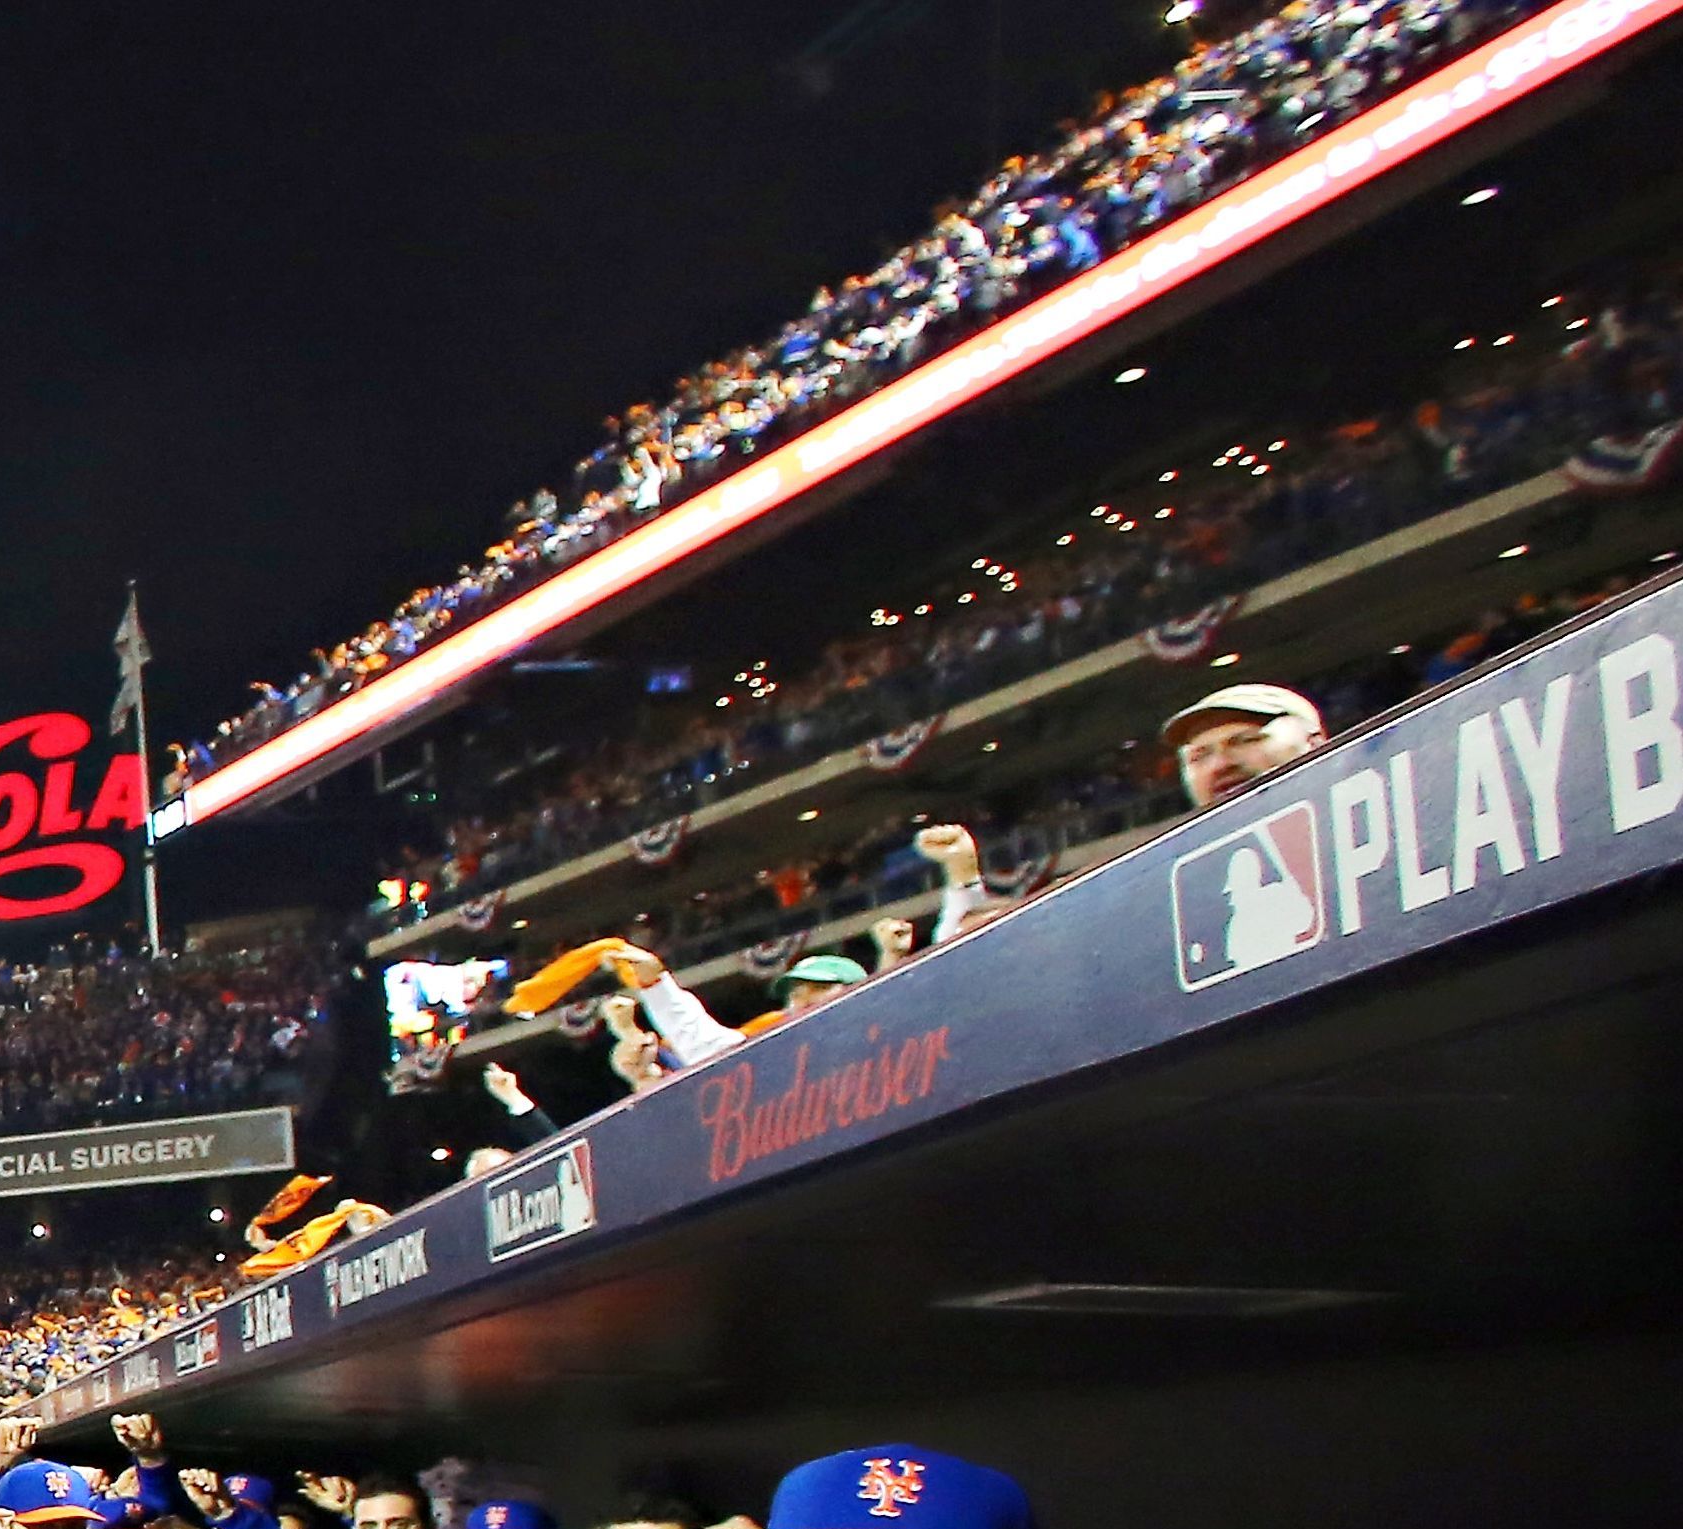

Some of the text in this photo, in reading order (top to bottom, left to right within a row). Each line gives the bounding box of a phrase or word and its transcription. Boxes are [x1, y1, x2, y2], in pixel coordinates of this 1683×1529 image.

[1331, 672, 1573, 936] PLAY
[69, 1133, 216, 1172] SURGERY
[697, 1023, 955, 1183] Budweiser
